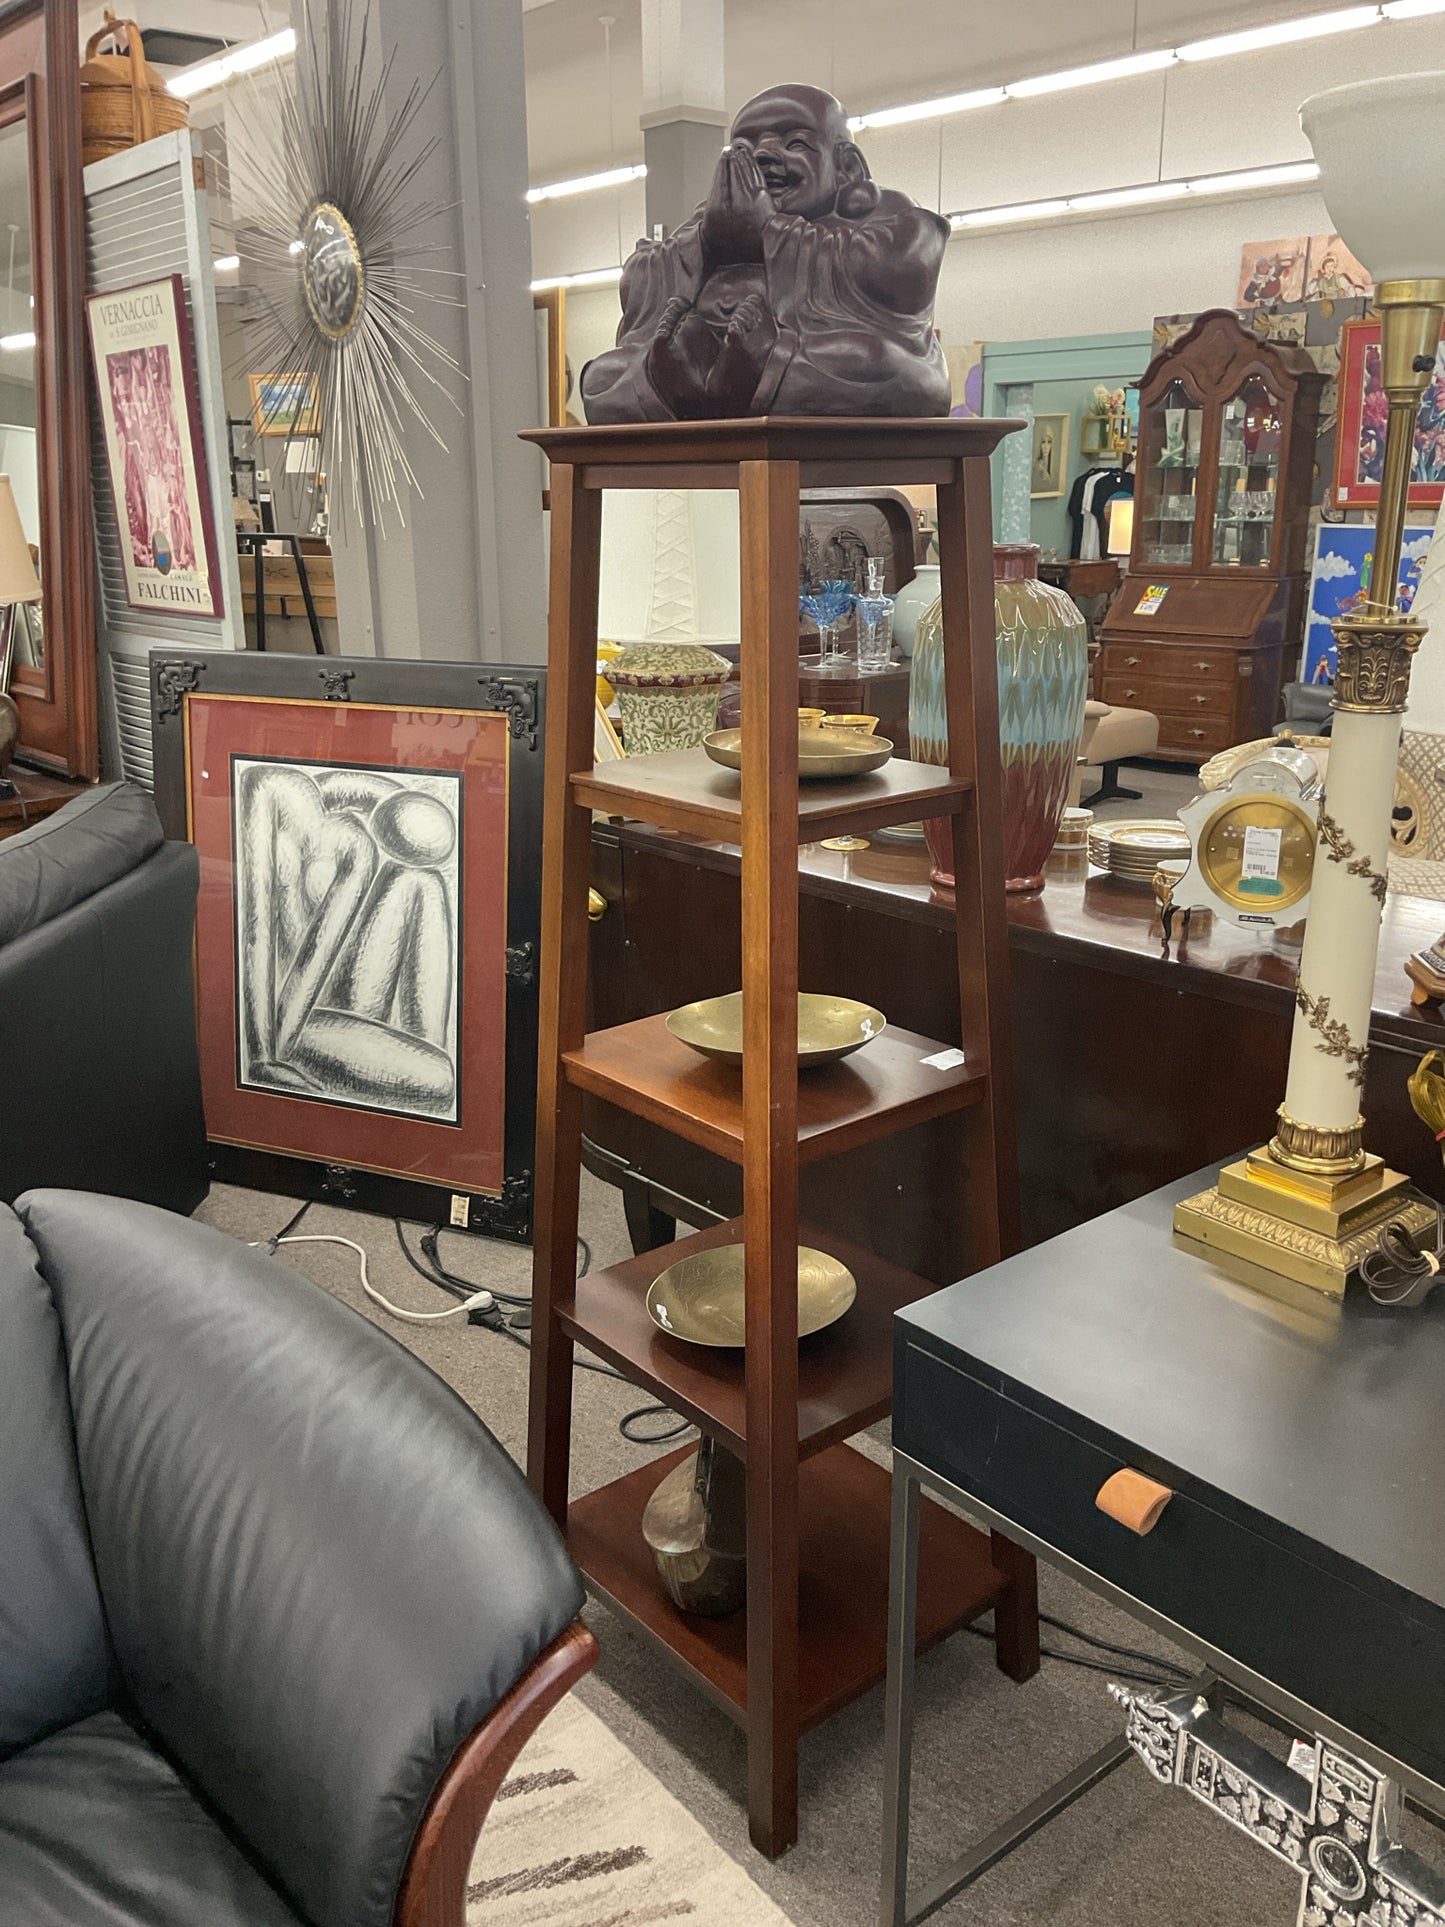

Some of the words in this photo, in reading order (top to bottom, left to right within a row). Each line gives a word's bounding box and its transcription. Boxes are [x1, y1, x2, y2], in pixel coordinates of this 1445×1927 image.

[100, 294, 163, 326] VERNACCIA
[138, 582, 202, 604] FALCHINI
[1143, 585, 1169, 601] SALE
